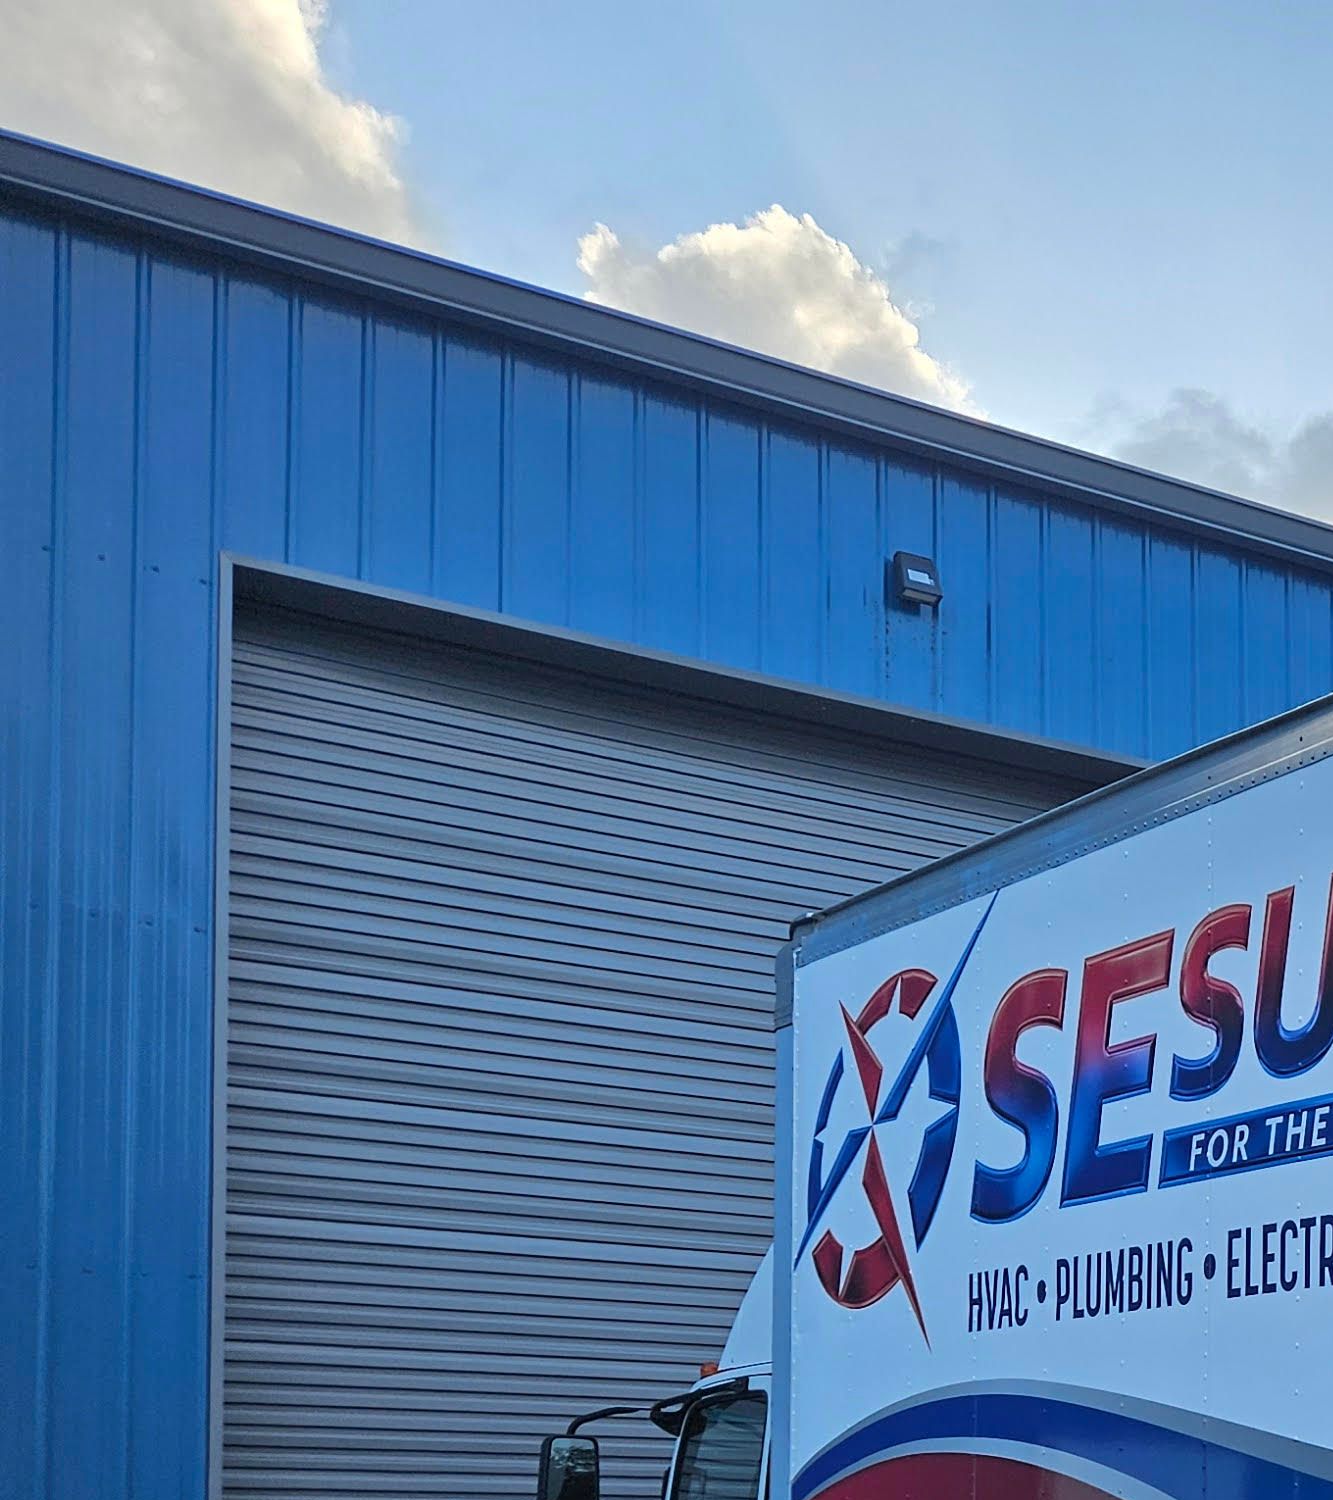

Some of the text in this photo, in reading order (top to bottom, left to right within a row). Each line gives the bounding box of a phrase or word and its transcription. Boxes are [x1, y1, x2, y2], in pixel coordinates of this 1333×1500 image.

[1188, 1132, 1249, 1172] FOR
[1266, 1113, 1328, 1156] THE
[967, 1271, 1029, 1333] HVAC
[1055, 1237, 1193, 1322] PLUMBING
